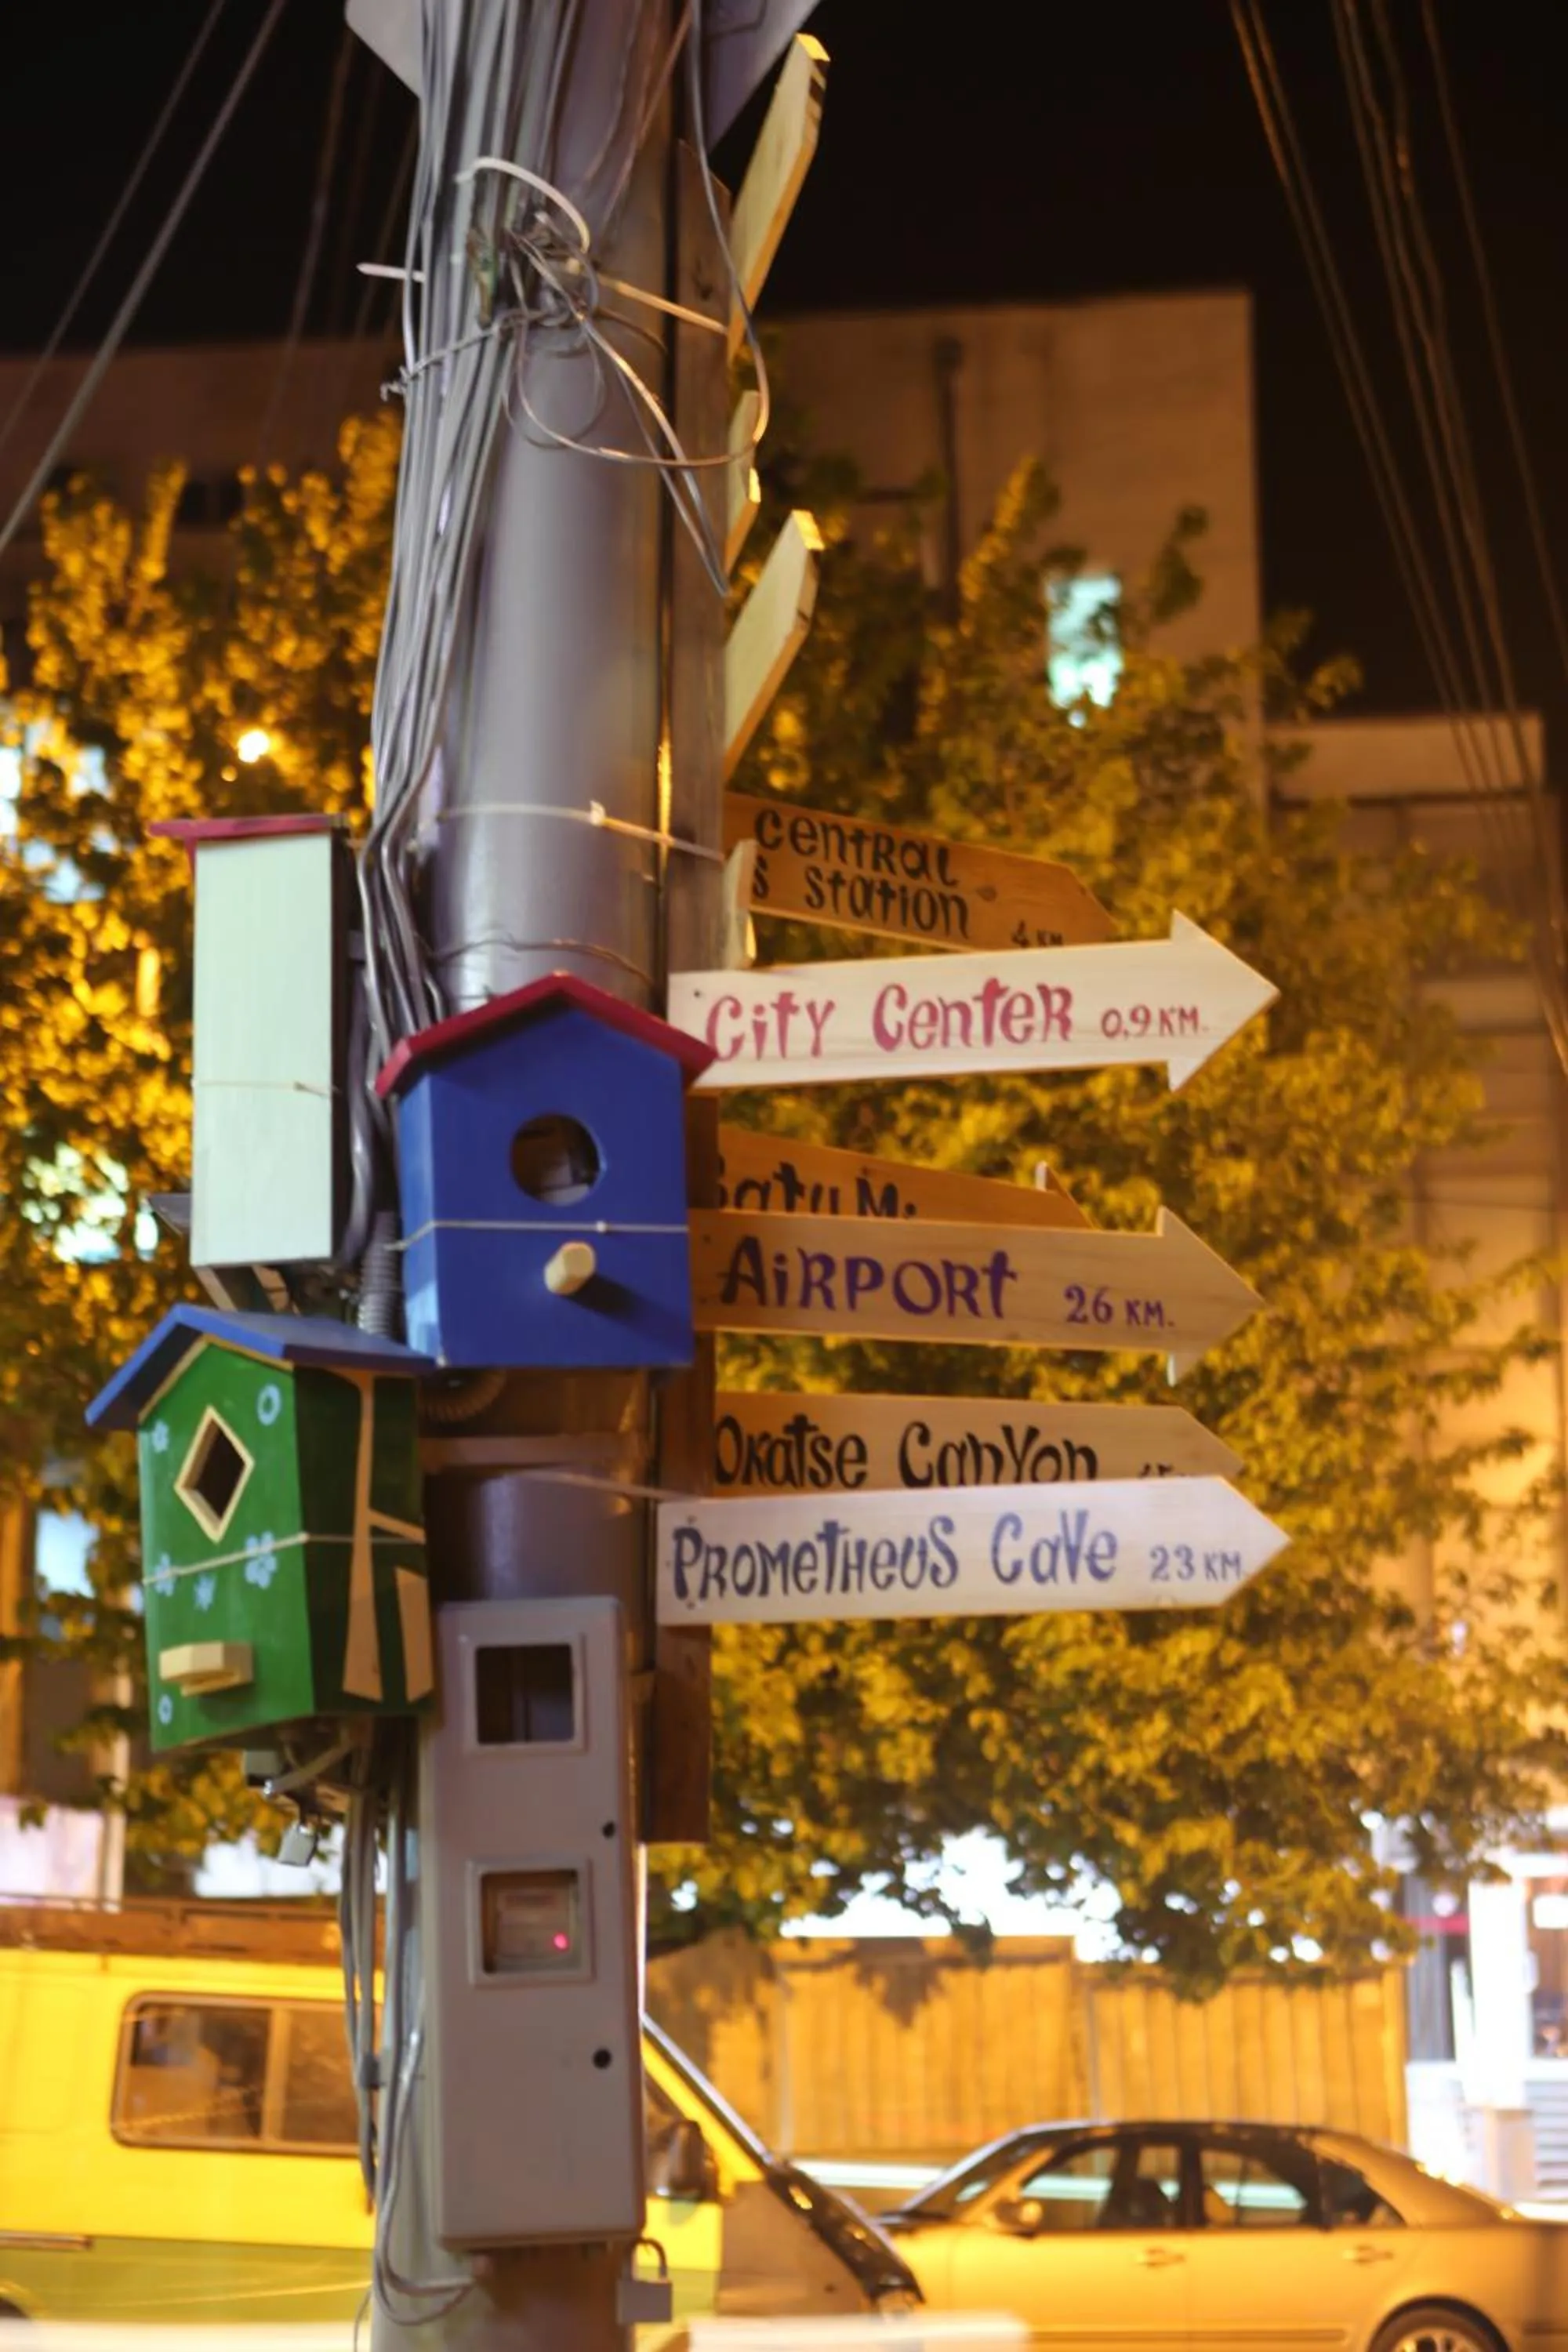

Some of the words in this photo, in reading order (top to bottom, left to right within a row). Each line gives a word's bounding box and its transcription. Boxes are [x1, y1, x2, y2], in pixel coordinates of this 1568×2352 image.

[804, 865, 969, 940] Station
[1063, 1283, 1113, 1324] 26
[1149, 1544, 1196, 1582] 23
